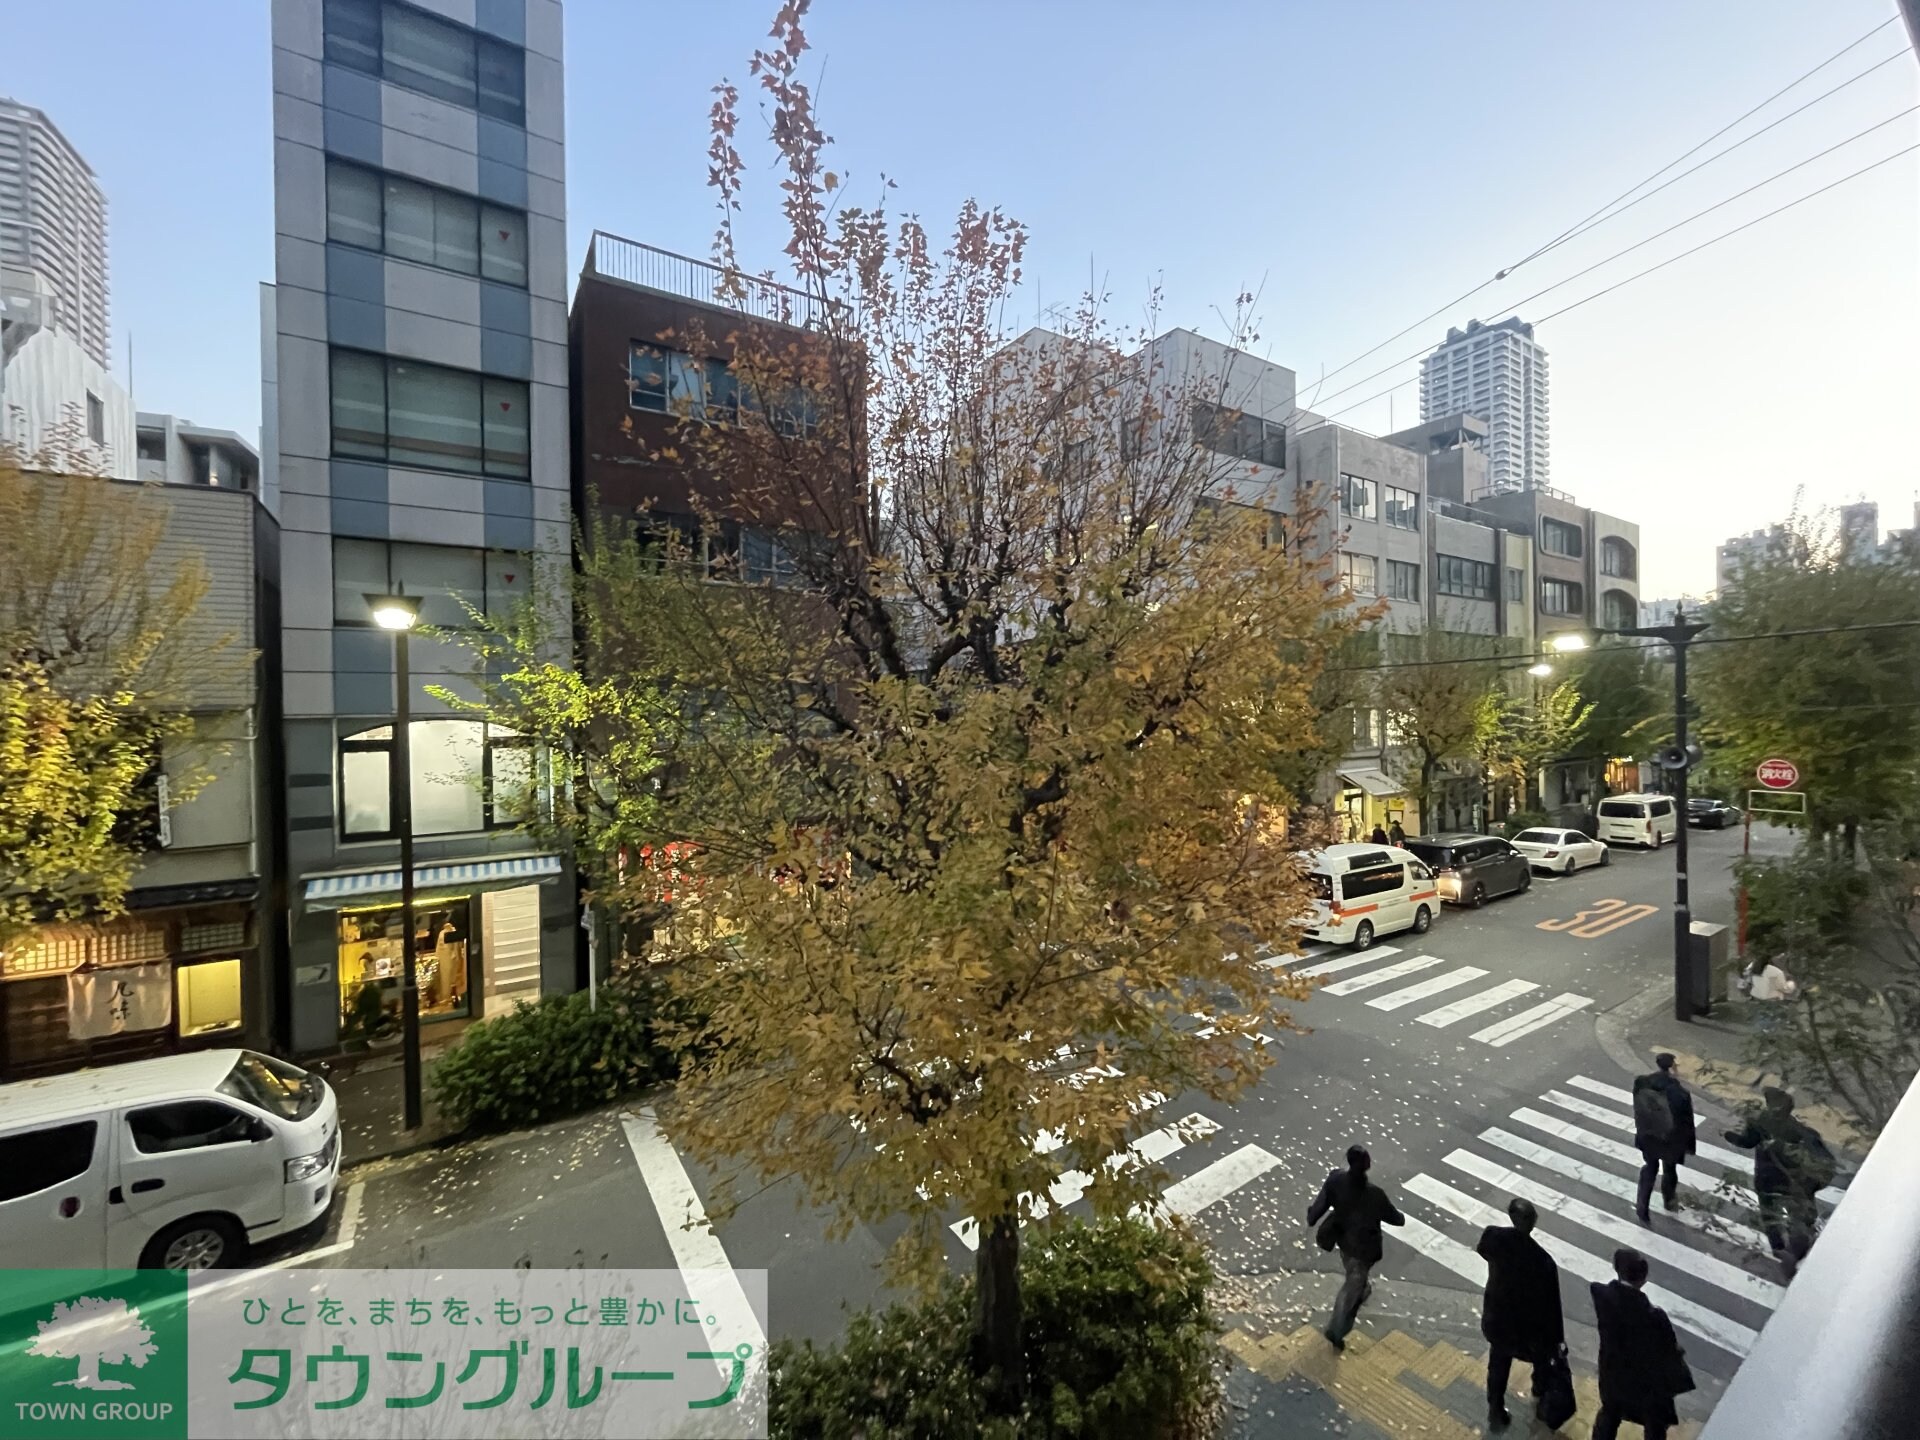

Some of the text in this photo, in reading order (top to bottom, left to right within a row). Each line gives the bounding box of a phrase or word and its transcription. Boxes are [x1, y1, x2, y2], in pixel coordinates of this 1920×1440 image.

[1761, 767, 1794, 780] 消火栓
[1535, 898, 1660, 938] 30
